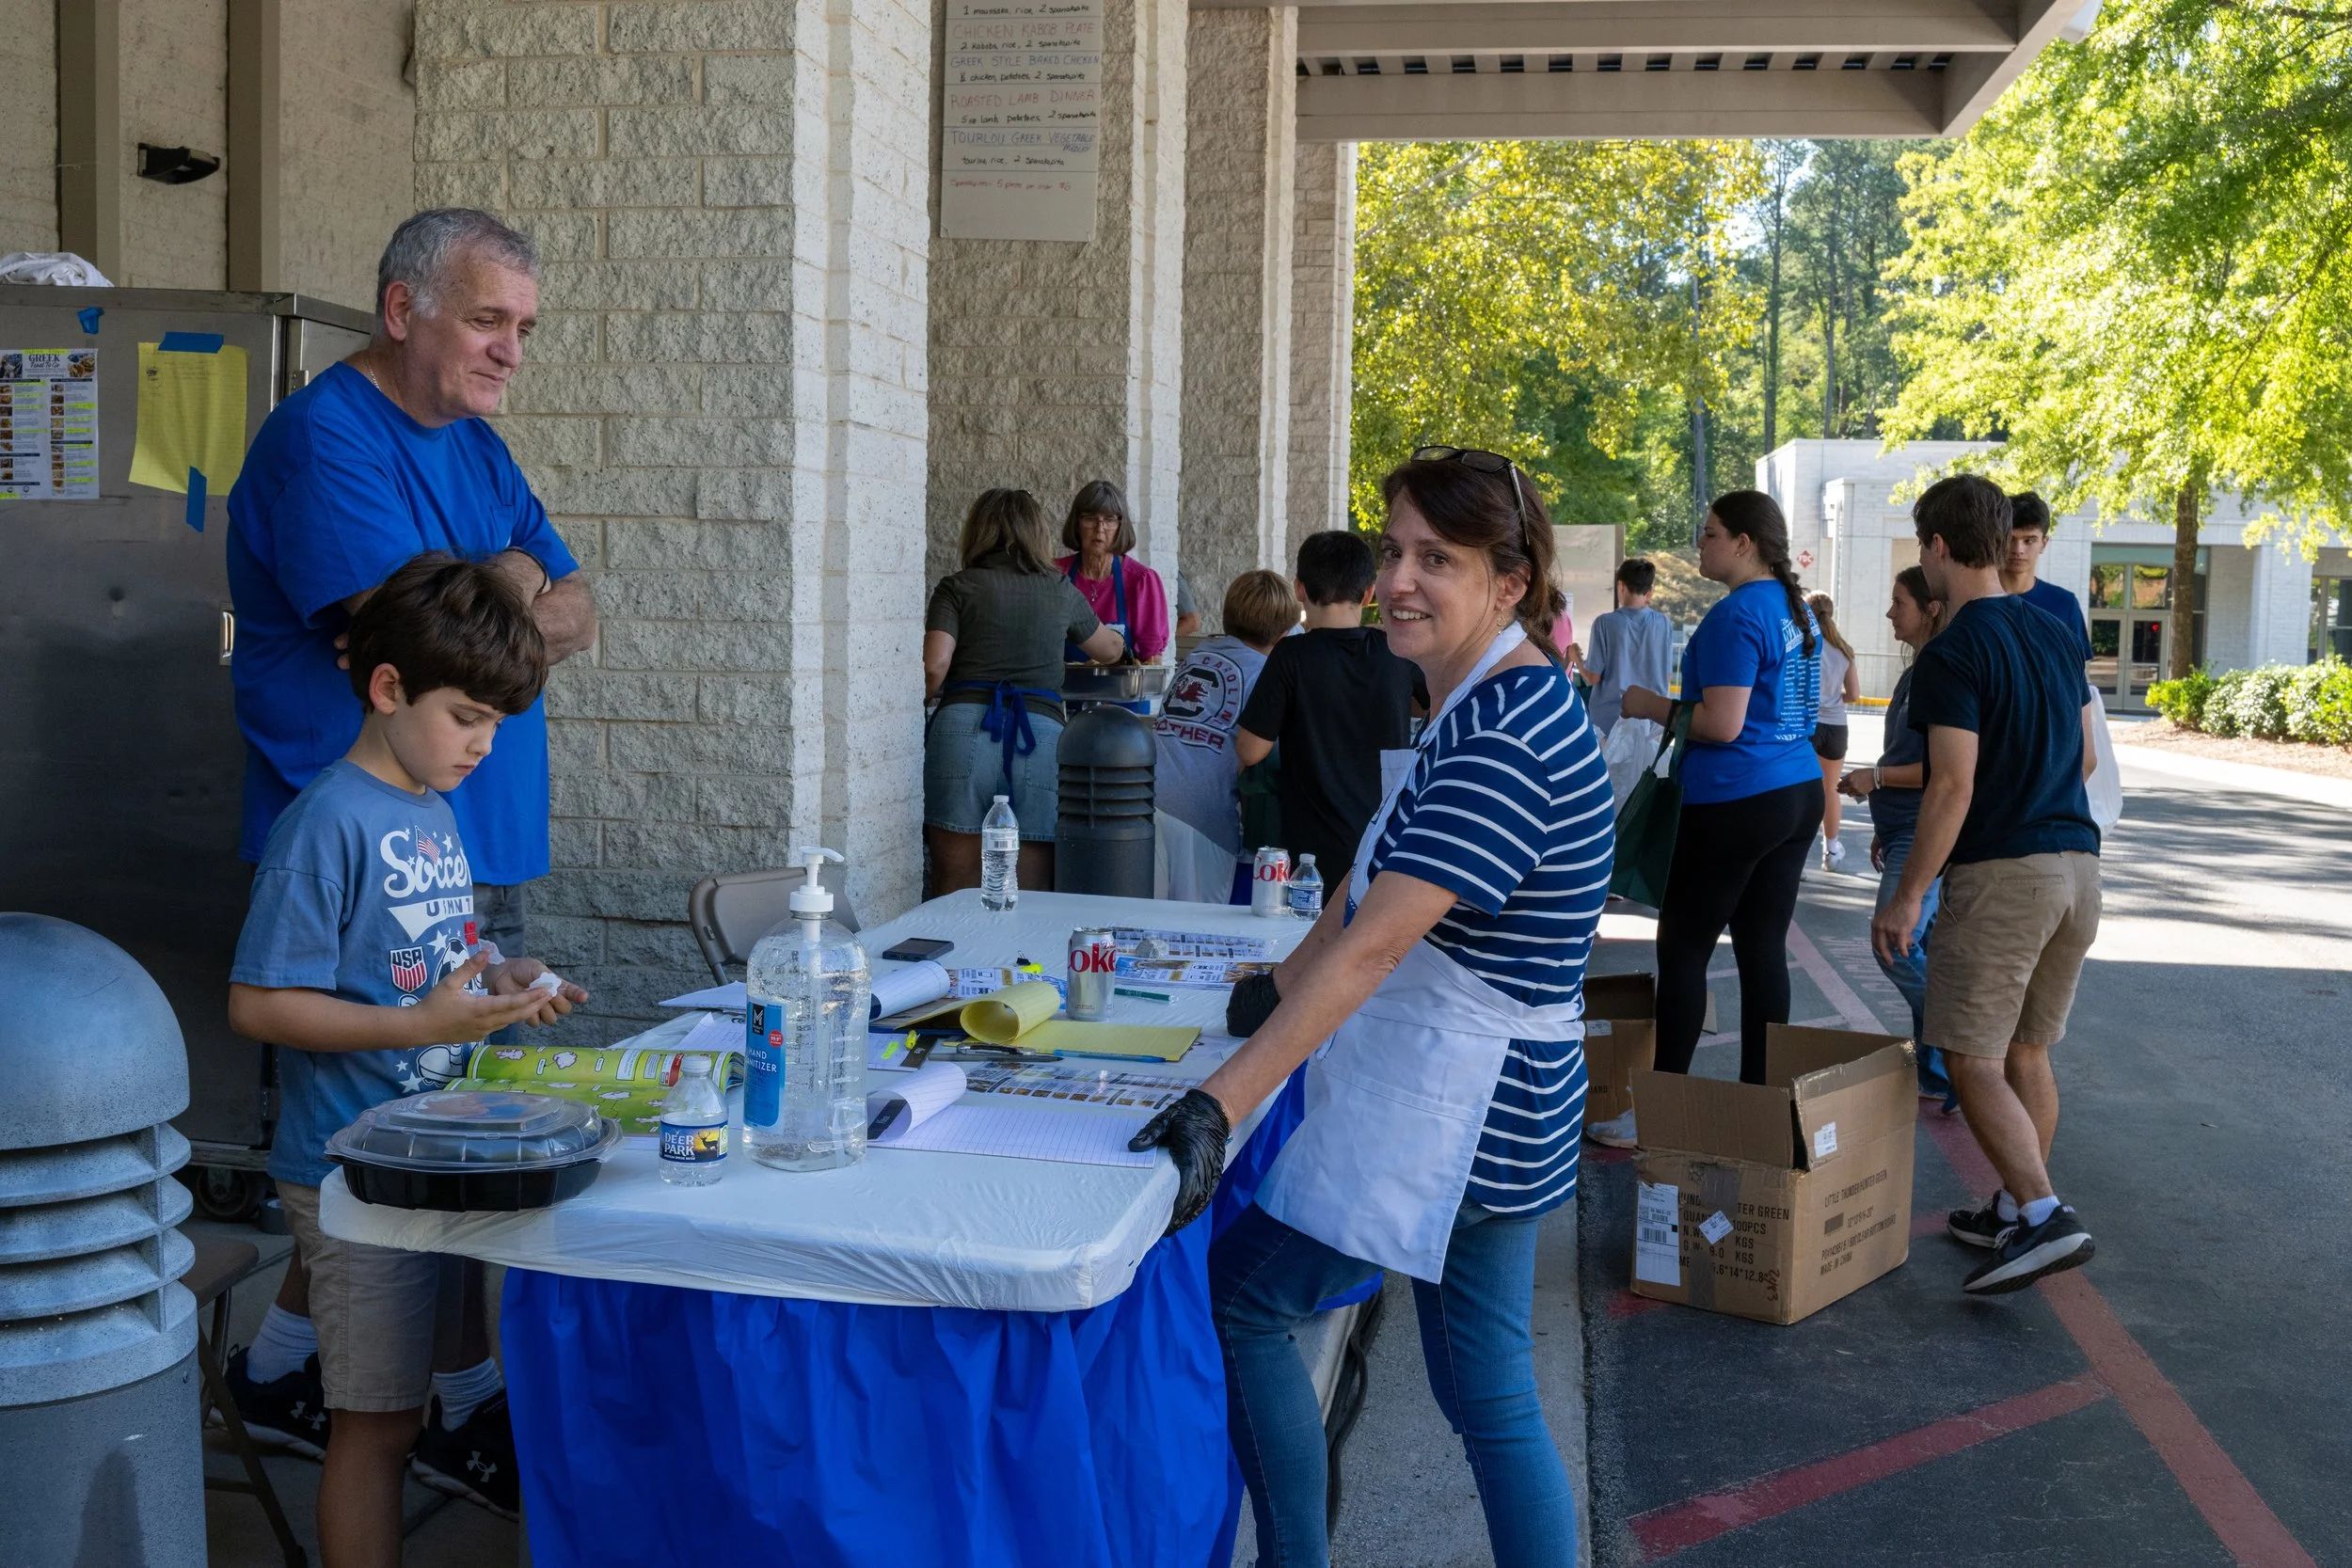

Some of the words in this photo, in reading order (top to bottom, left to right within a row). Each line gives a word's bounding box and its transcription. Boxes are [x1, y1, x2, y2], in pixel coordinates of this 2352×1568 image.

[1039, 5, 1046, 13] 2
[952, 24, 1013, 40] CHICKEN
[1022, 23, 1058, 38] KABOB
[1065, 22, 1095, 35] PLATE
[961, 41, 968, 51] 2
[950, 56, 983, 69] GREEK
[992, 56, 1022, 67] STYLE
[1028, 55, 1060, 66] BAKED
[1063, 55, 1100, 65] CHICKEN
[1034, 71, 1041, 80] 2
[950, 94, 1002, 110] ROASTED
[1009, 95, 1040, 107] LAMB
[1050, 89, 1095, 103] DINNER
[1048, 110, 1057, 119] 2
[951, 128, 1006, 145] TOURLOU
[1011, 131, 1042, 144] GREEK
[1048, 131, 1096, 144] VEGETABLE
[1014, 155, 1022, 164] 2
[28, 353, 60, 362] GREEK
[1153, 718, 1225, 751] OTHER
[1253, 856, 1290, 882] Cok
[391, 948, 422, 968] USA
[1068, 943, 1116, 974] oke
[748, 1047, 768, 1060] HAND
[746, 1056, 777, 1073] ANITIZER
[664, 1132, 694, 1145] DEER
[664, 1143, 695, 1157] PARK
[1824, 1191, 1839, 1208] LITTLE
[1738, 1202, 1755, 1215] TER
[1757, 1205, 1790, 1220] GREEN
[1735, 1236, 1755, 1249] KGS
[1709, 1246, 1724, 1259] 9.0
[1735, 1251, 1755, 1264] KGS
